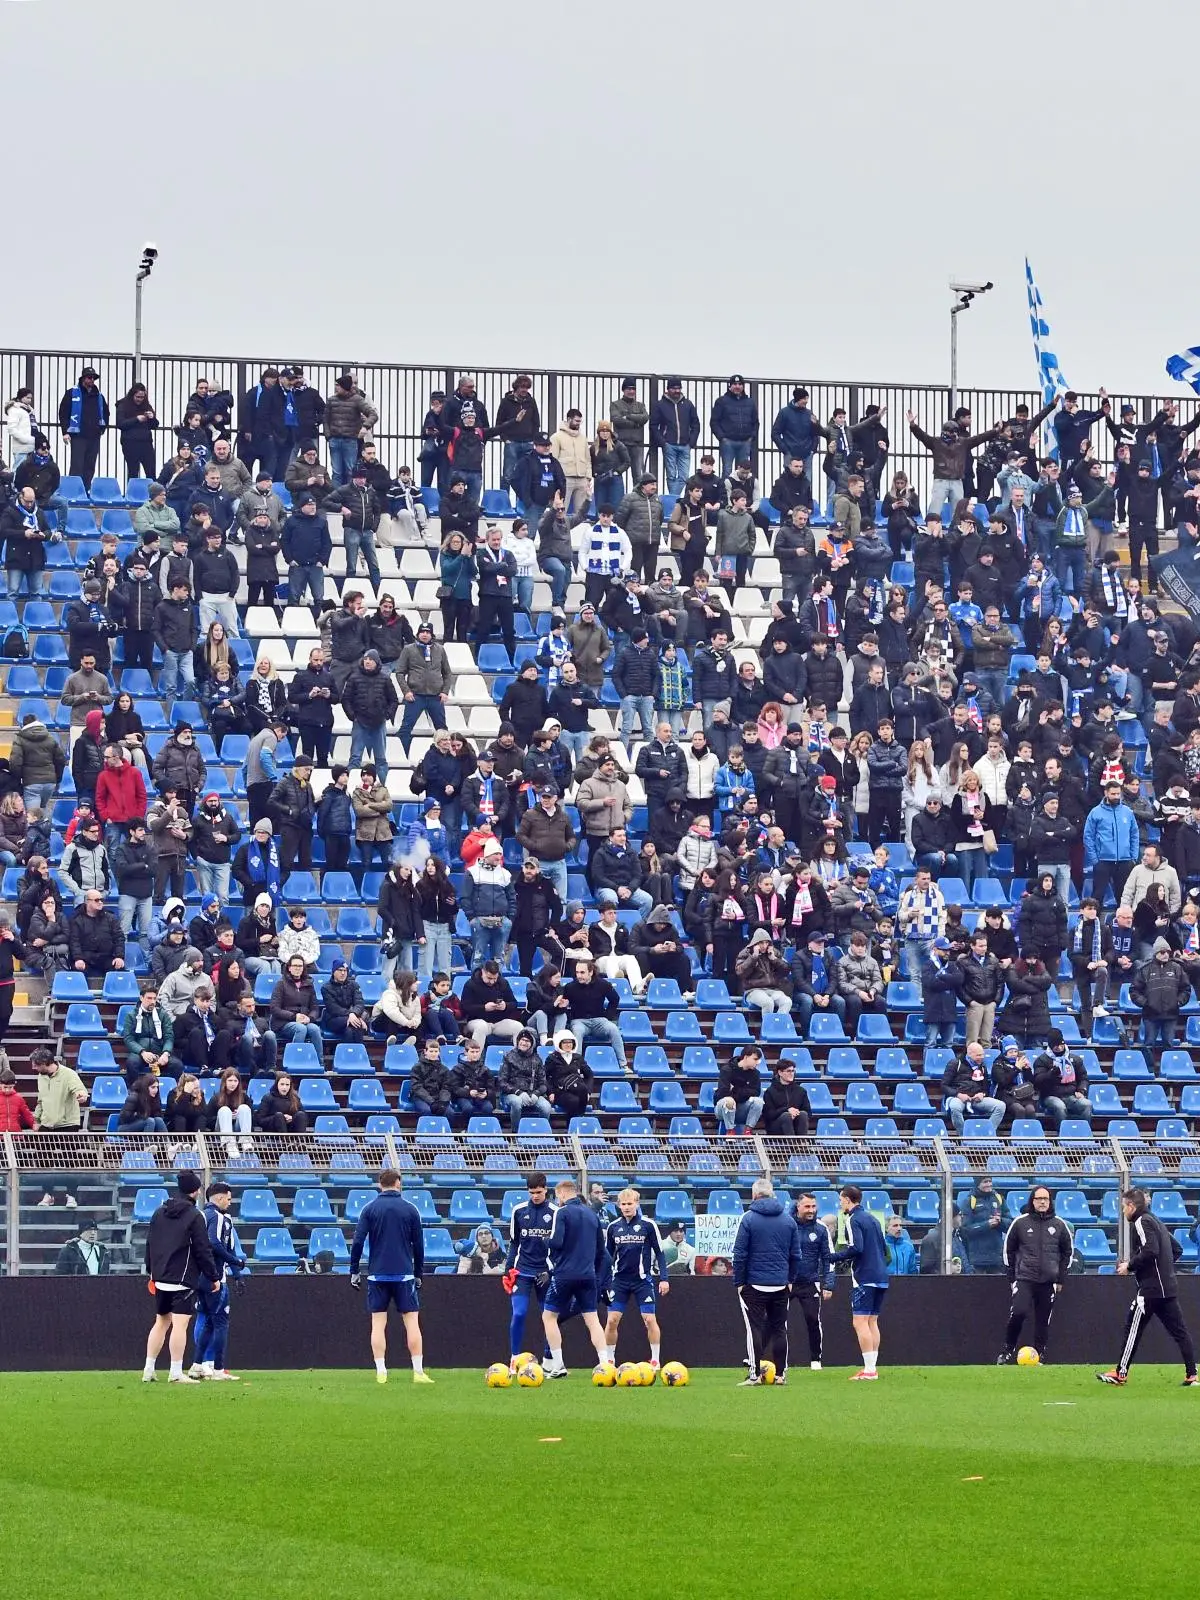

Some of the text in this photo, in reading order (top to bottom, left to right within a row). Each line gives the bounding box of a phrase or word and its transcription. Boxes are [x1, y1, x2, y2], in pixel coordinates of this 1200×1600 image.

[698, 1216, 721, 1229] DIAO
[699, 1230, 709, 1239] TU
[698, 1241, 713, 1253] POR
